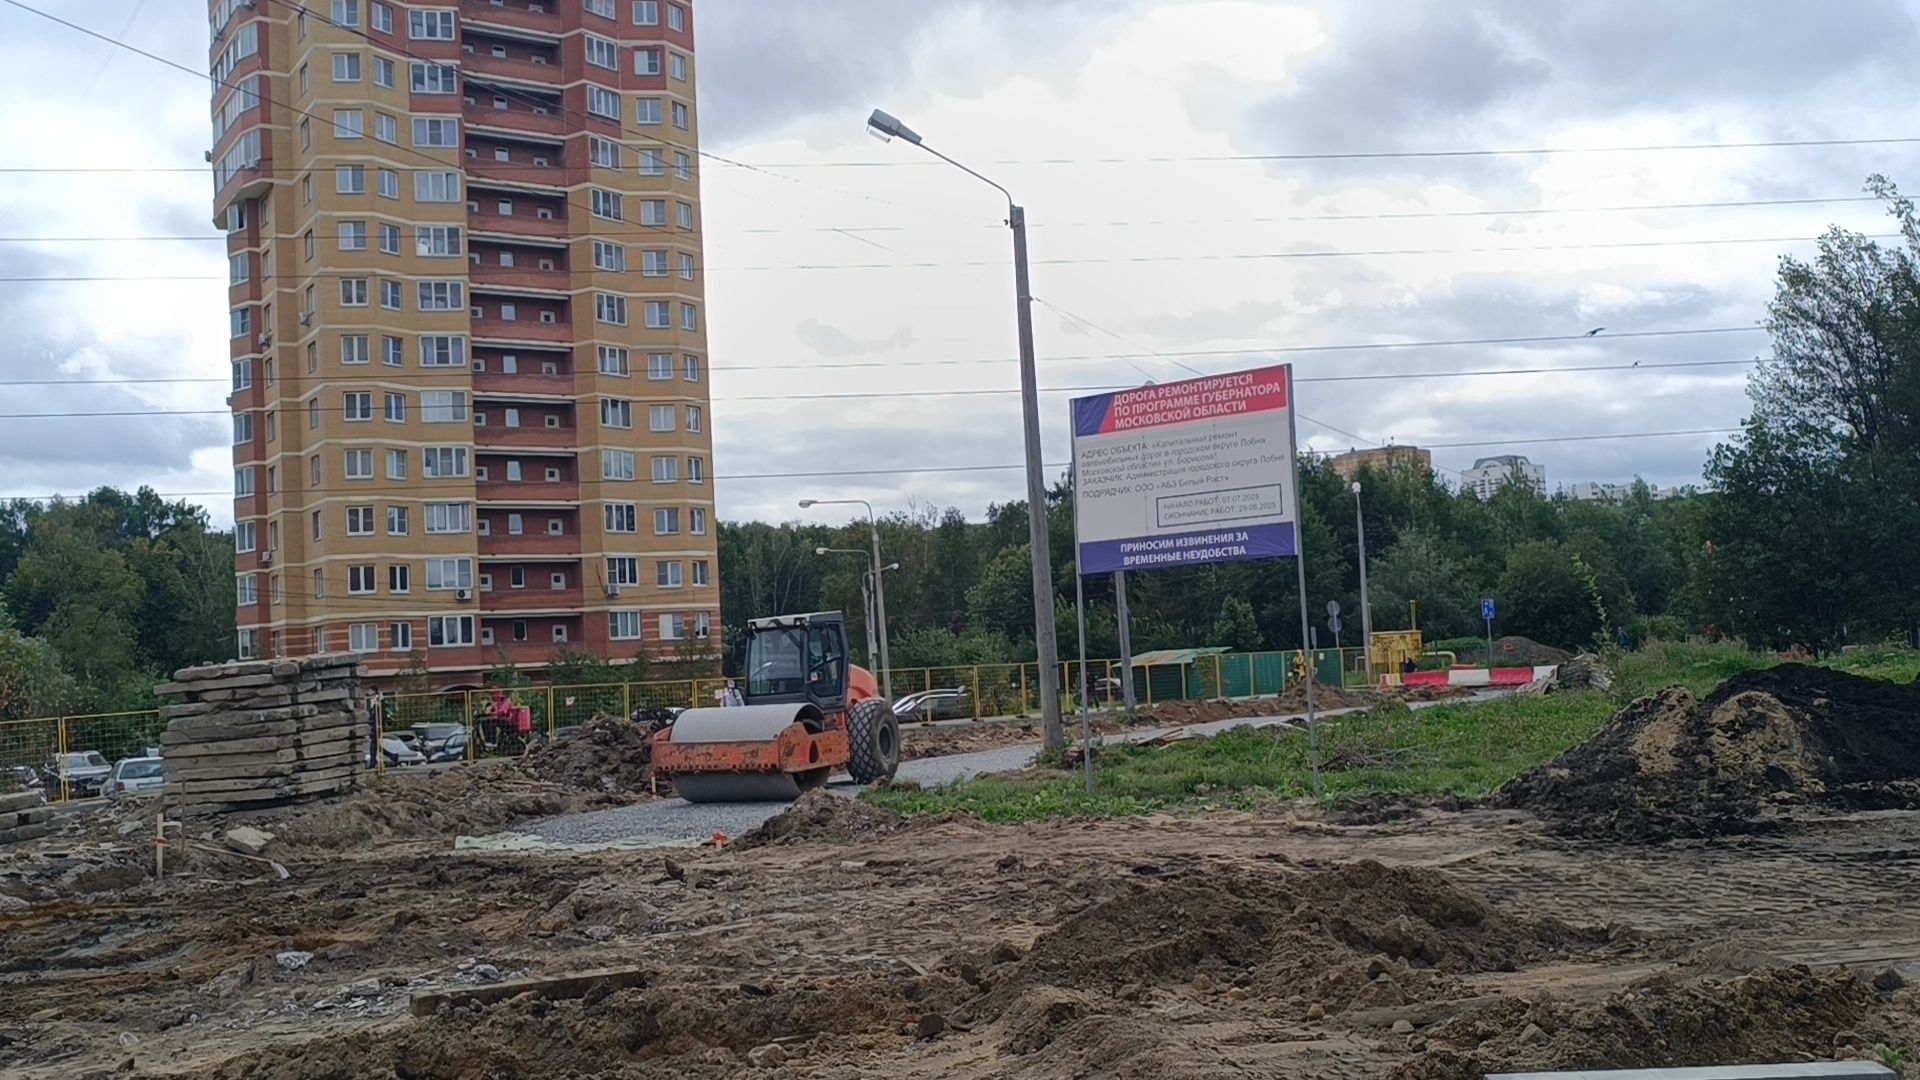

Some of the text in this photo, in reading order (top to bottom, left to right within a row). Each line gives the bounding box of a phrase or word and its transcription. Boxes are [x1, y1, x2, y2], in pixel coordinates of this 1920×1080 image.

[1113, 374, 1253, 407] ДОРОГА РЕМОНТИРУЕТСЯ
[1114, 382, 1281, 417] ПО ПРОГРАММЕ ГУБЕРНАТОРА
[1115, 400, 1247, 429] МОСКОВСКОЙ ОБЛАСТИ
[1081, 448, 1109, 460] АДРЕС
[1134, 482, 1154, 493] ООО
[1163, 500, 1193, 510] НАЧАЛО
[1163, 508, 1209, 520] ОКОНЧАНИЕ
[1120, 531, 1249, 553] ПРИНОСИМ ИЗВИНЕНИЯ ЗА
[1123, 546, 1247, 566] ВРЕМЕННЫЕ НЕУДОБСТВА
